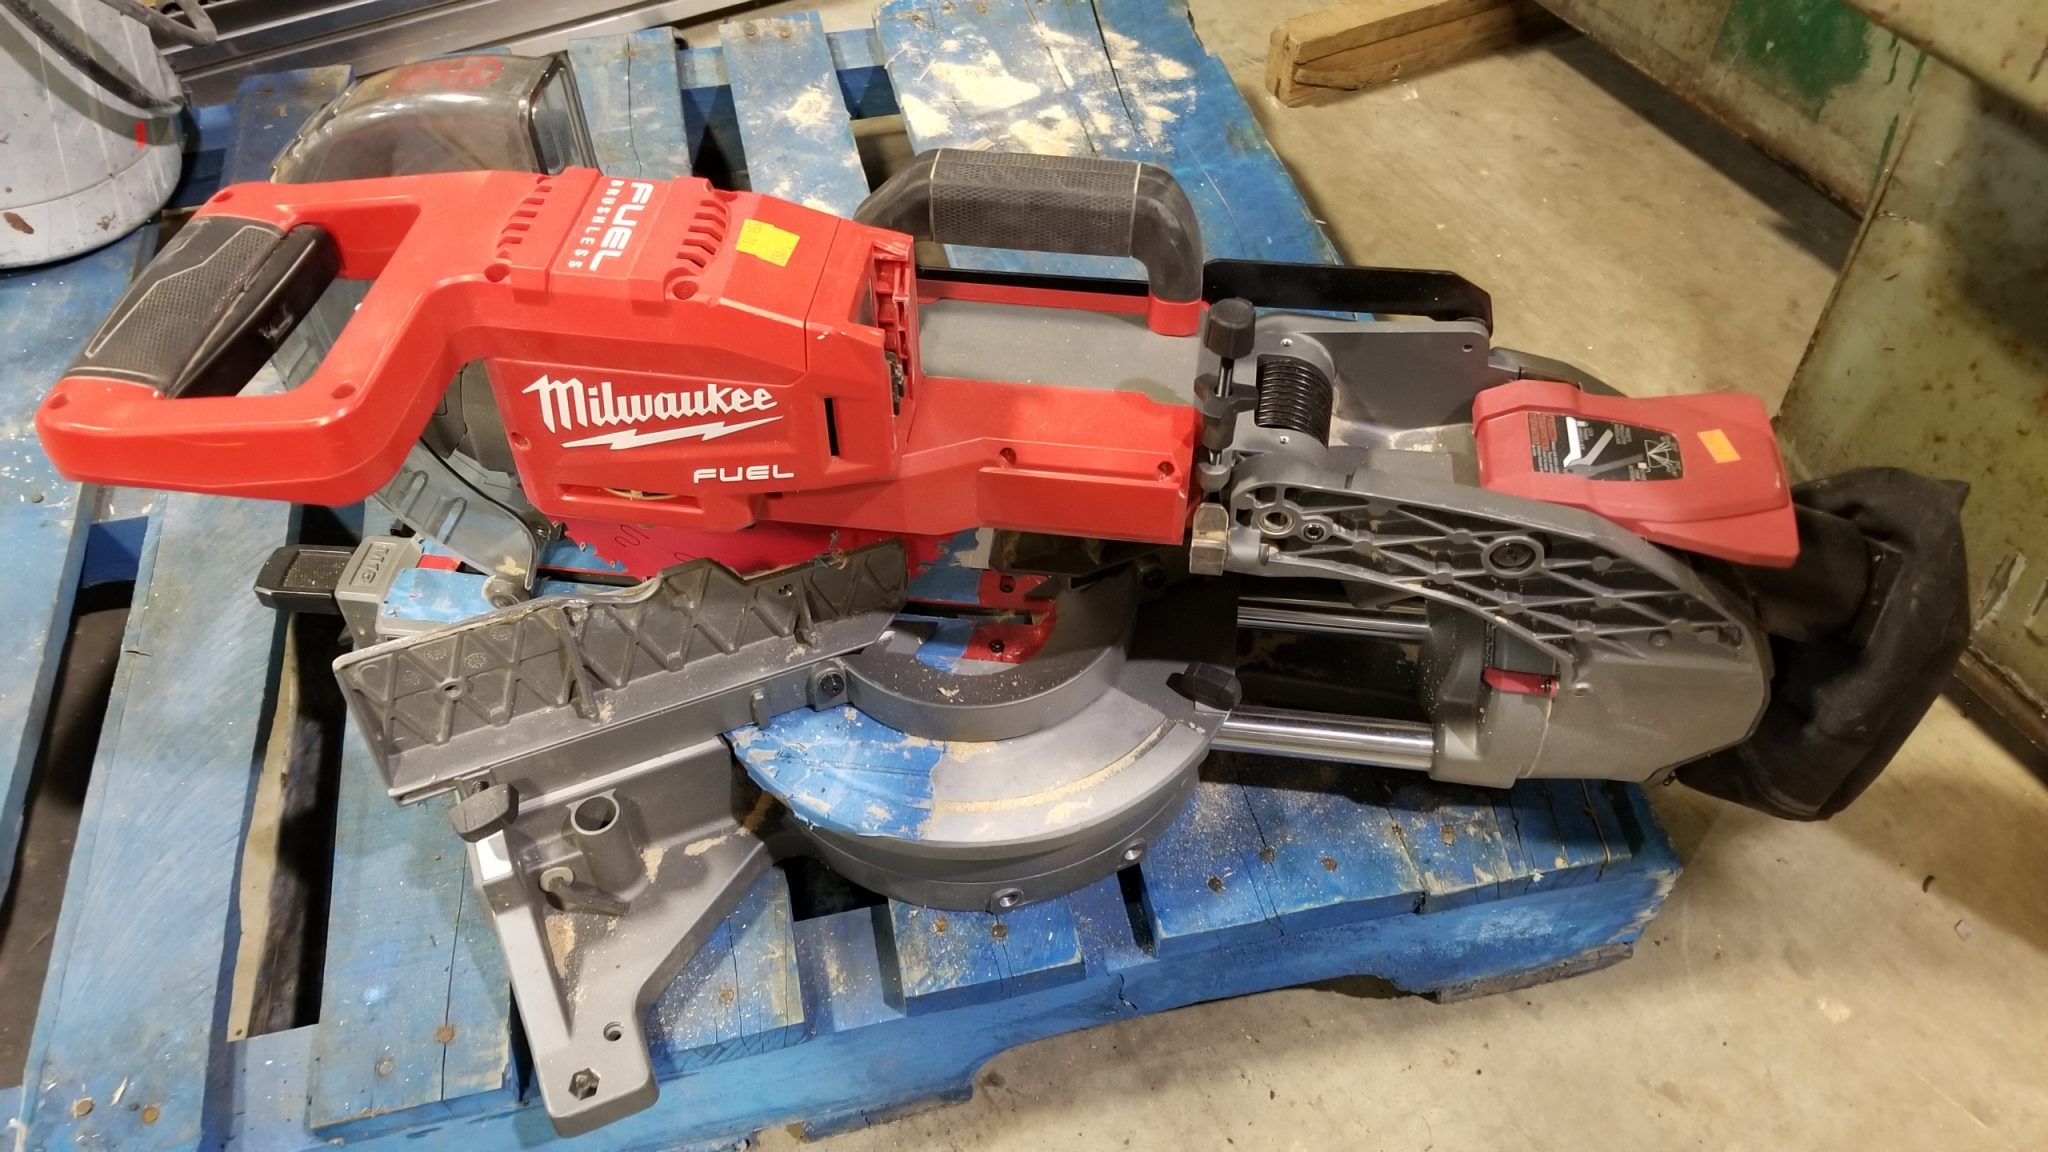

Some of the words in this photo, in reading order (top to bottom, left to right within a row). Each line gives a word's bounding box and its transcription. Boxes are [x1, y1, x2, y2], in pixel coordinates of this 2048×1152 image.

[567, 179, 625, 268] BRUSHLESS
[588, 181, 655, 272] FUEL
[521, 373, 779, 434] Milwaukee
[692, 464, 795, 484] FUEL
